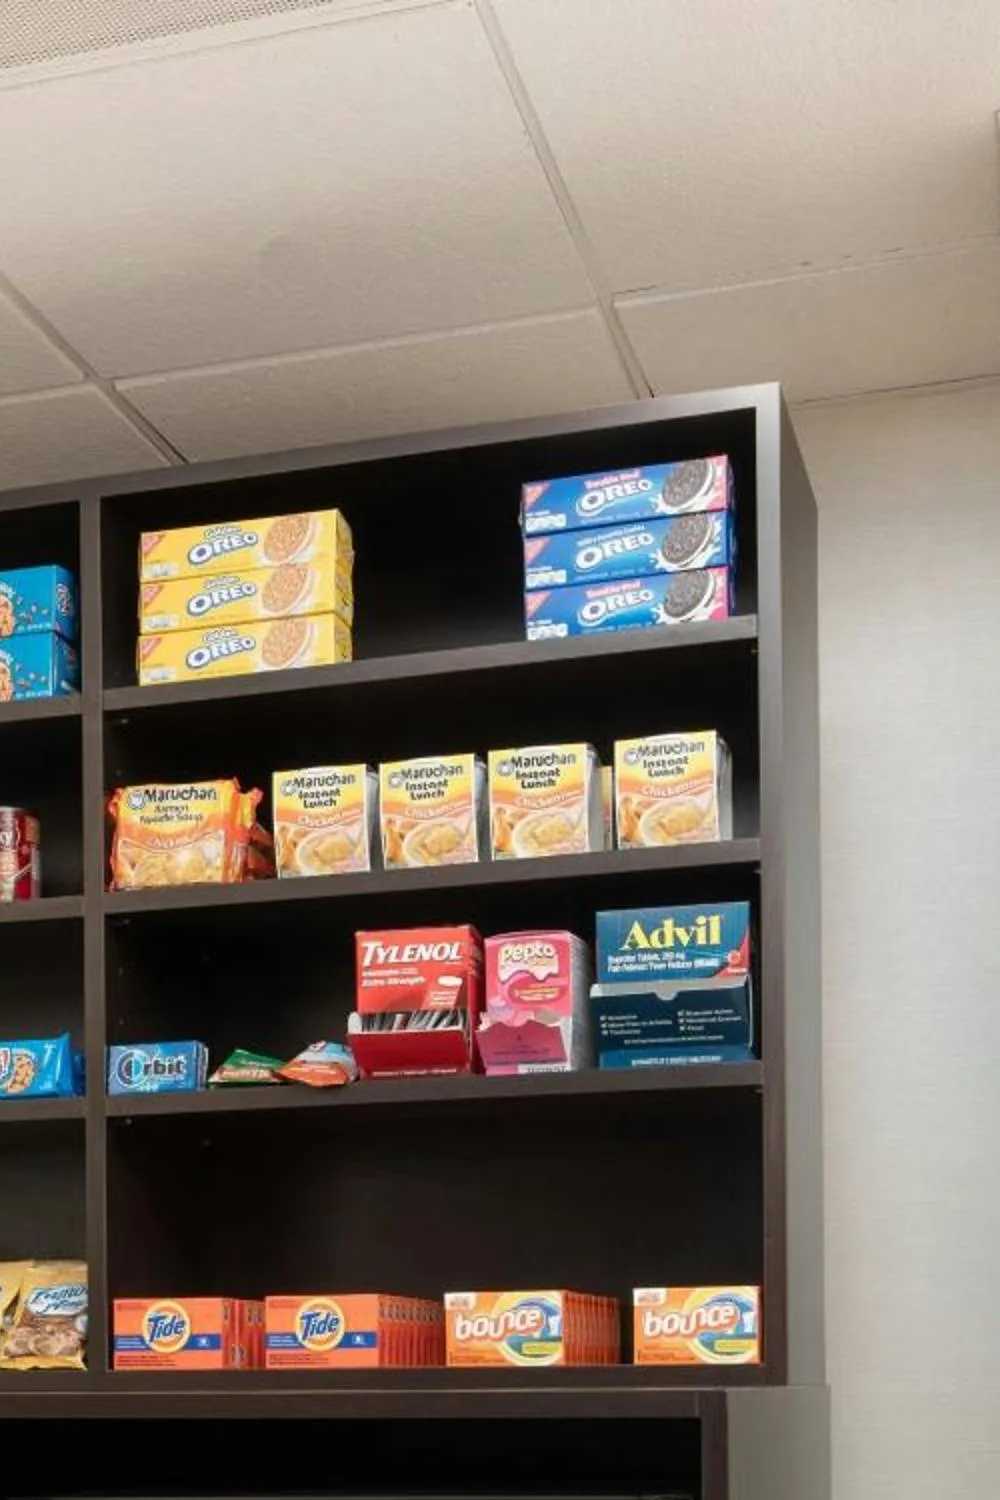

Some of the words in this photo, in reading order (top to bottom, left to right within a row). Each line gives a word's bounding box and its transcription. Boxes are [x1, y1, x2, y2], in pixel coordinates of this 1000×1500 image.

[577, 478, 653, 514] OREO
[187, 532, 259, 565] OREO
[575, 532, 654, 571] OREO
[186, 583, 257, 616] OREO
[578, 589, 654, 625] OREO
[185, 636, 256, 669] OREO
[511, 752, 576, 768] Maruchan
[637, 740, 705, 757] Maruchan
[643, 756, 689, 769] Instant
[293, 772, 356, 788] Maruchan
[400, 764, 463, 779] Maruchan
[405, 779, 449, 792] Instant
[521, 778, 556, 789] Lunch
[145, 787, 217, 803] Maruchan
[303, 798, 337, 809] Lunch
[410, 790, 445, 801] Lunch
[619, 914, 721, 950] Advil
[361, 941, 464, 966] TYLENOL
[116, 1050, 188, 1088] Orbit
[147, 1311, 186, 1342] Tide
[300, 1309, 339, 1341] Tide
[455, 1306, 541, 1339] bounce
[644, 1303, 737, 1338] bounce
